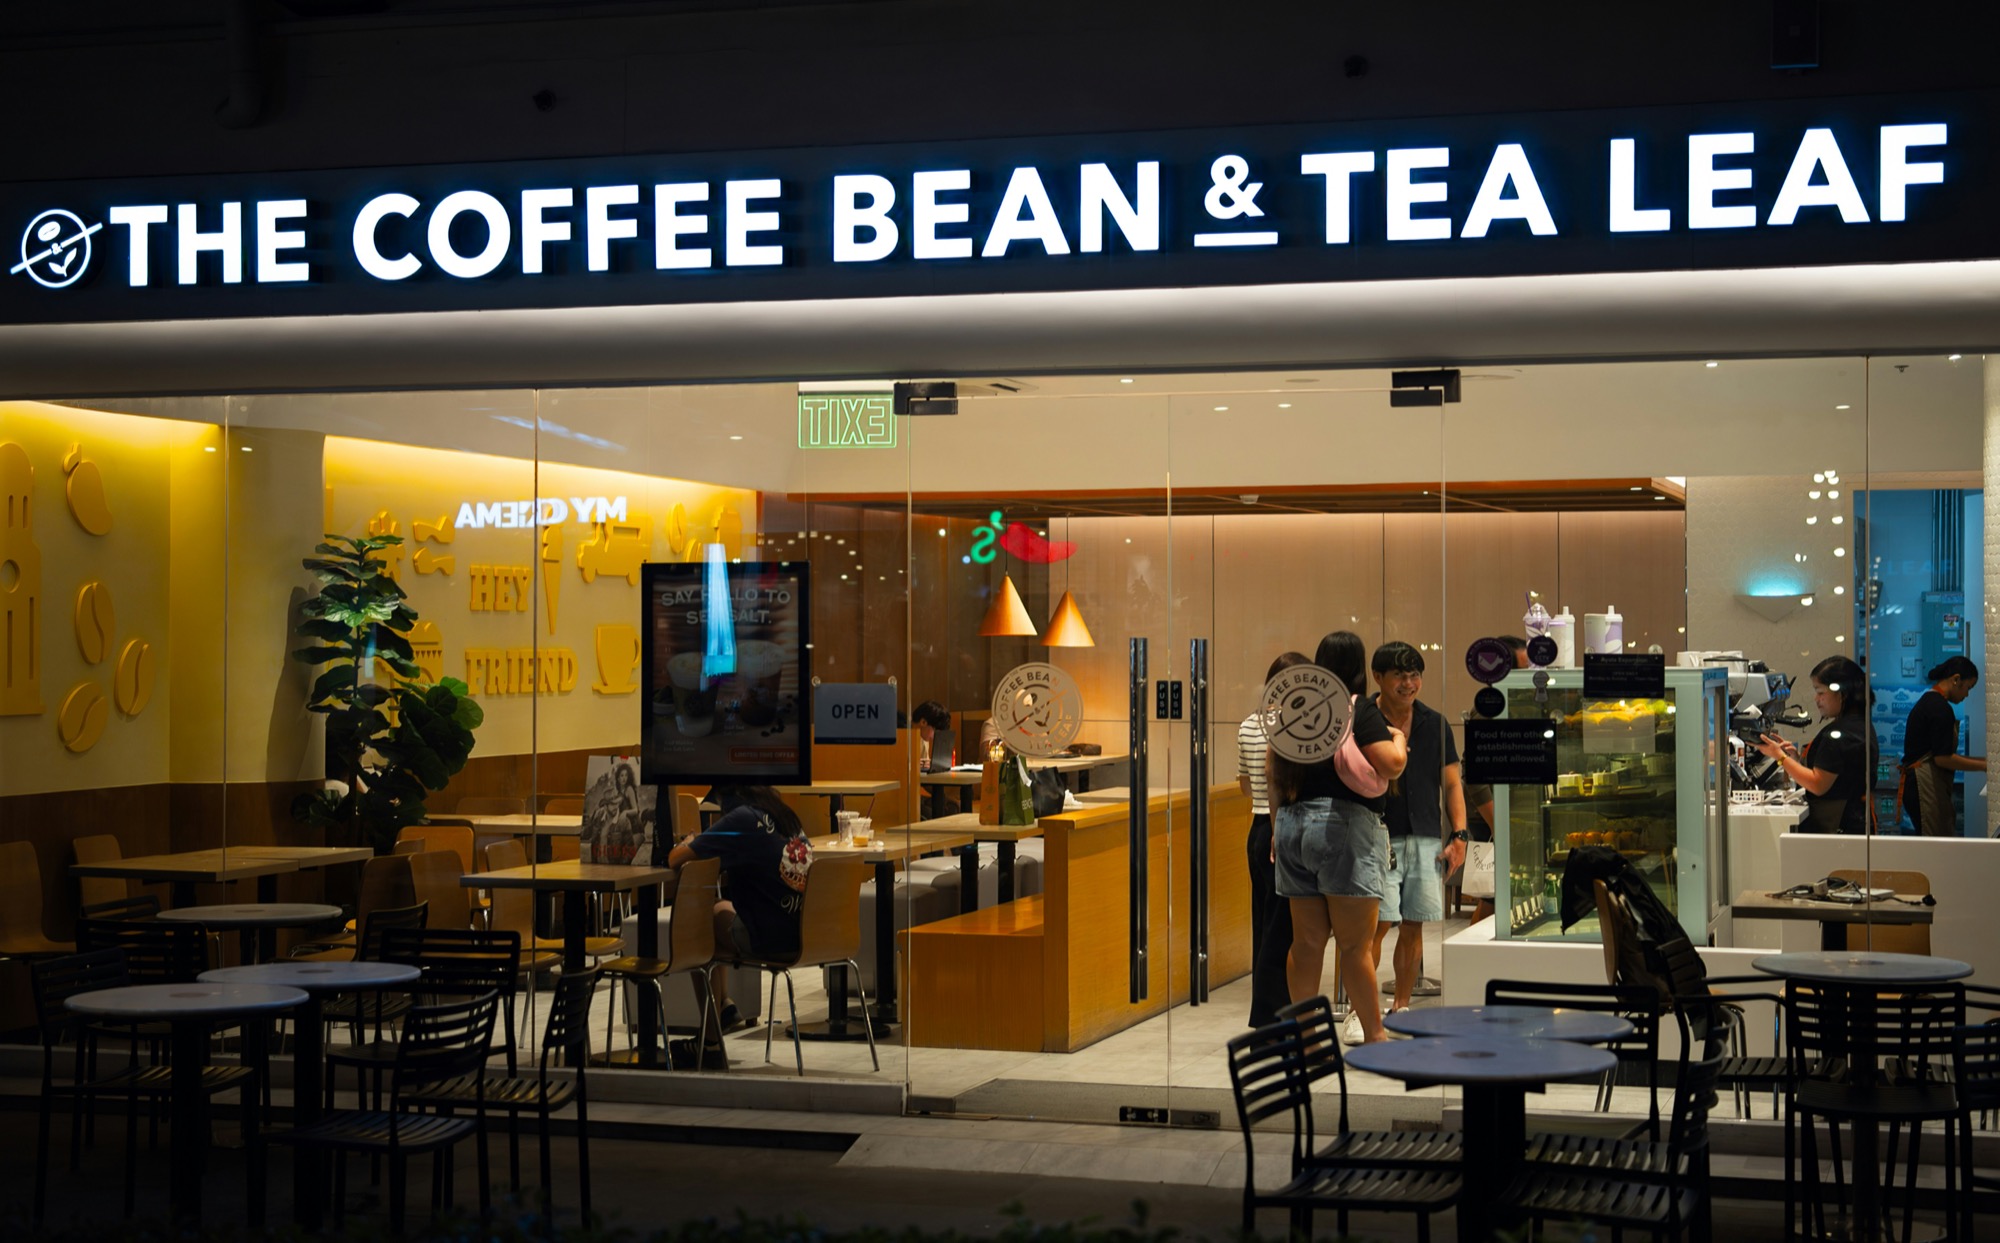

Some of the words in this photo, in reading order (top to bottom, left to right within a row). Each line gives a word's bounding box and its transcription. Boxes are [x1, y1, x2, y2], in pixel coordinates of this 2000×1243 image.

[110, 200, 309, 286] THE
[353, 180, 782, 281] COFFEE
[834, 162, 1160, 262] BEAN
[1200, 155, 1271, 232] &
[1301, 143, 1557, 243] TEA
[1609, 124, 1947, 232] LEAF
[469, 565, 533, 612] HEY
[661, 590, 694, 606] SAY
[701, 588, 758, 602] HLO
[765, 588, 791, 604] TO
[686, 610, 712, 625] SE
[730, 609, 772, 624] SALT.
[465, 648, 578, 695] FRIEND
[1294, 674, 1329, 689] BEAN
[1000, 676, 1024, 721] COFFEE
[1026, 671, 1060, 687] BEAN
[1266, 679, 1290, 726] COFFEE
[832, 704, 879, 719] OPEN
[1323, 717, 1342, 747] LEAF
[1474, 730, 1498, 738] Food
[1500, 730, 1521, 738] from
[1524, 730, 1546, 738] othe
[1297, 743, 1322, 754] TEA
[1476, 742, 1546, 750] establishments
[1492, 755, 1508, 763] not
